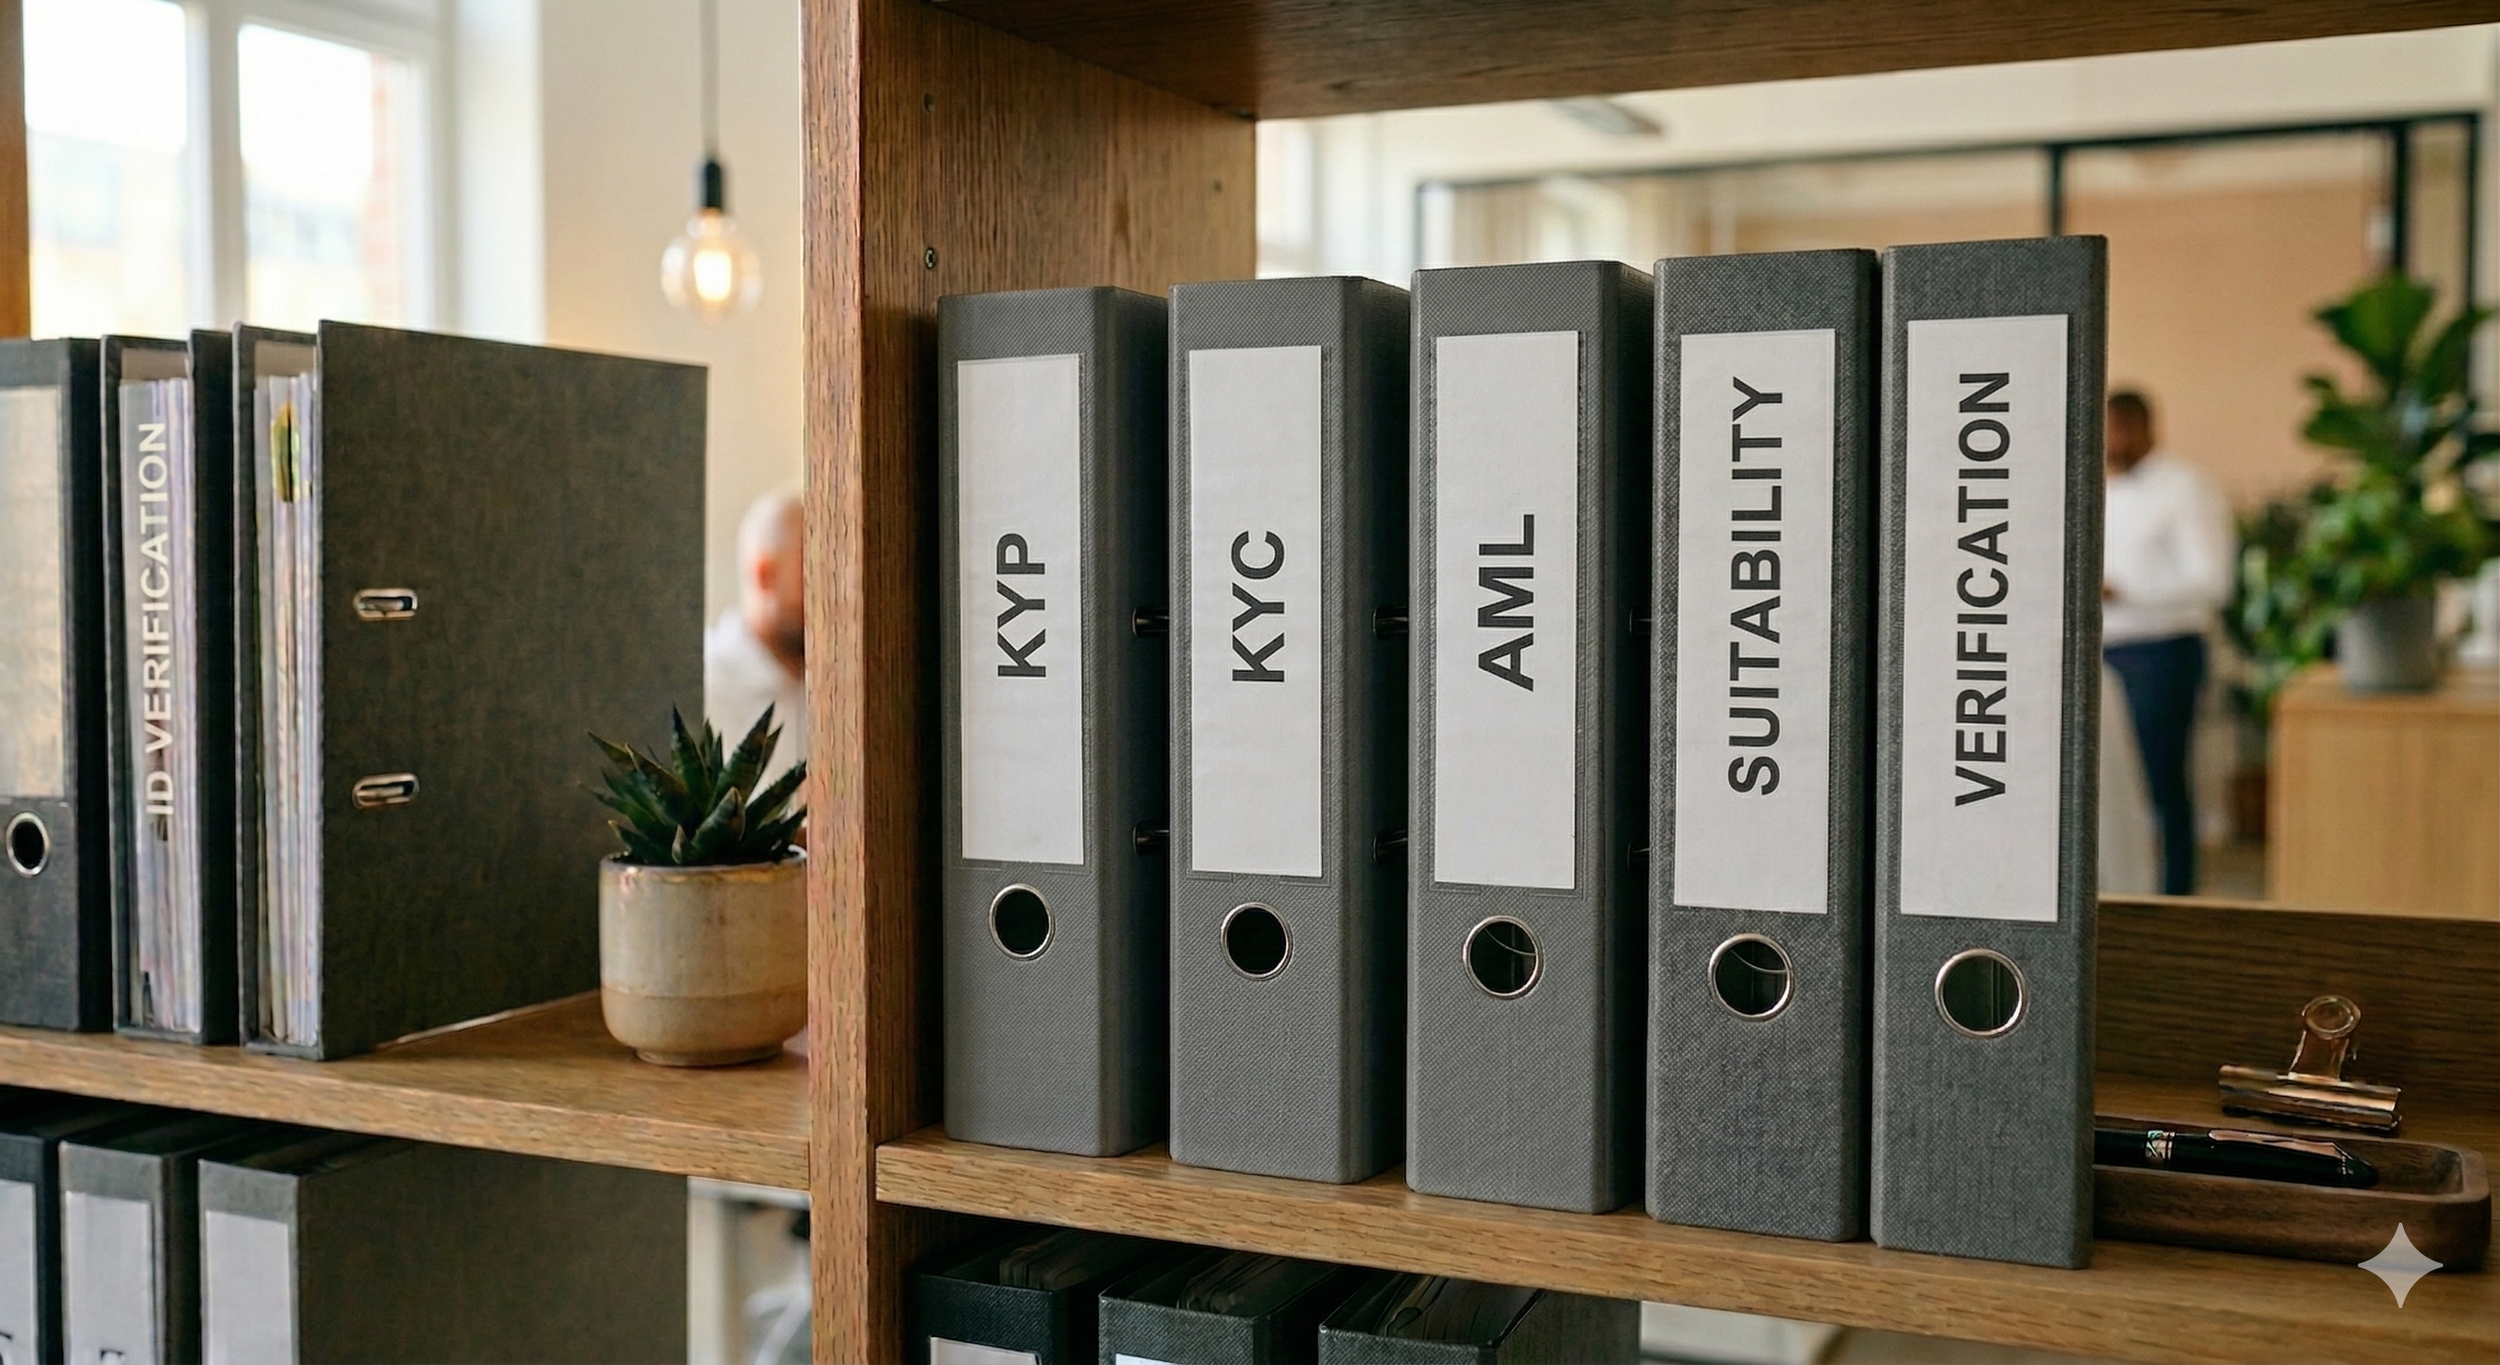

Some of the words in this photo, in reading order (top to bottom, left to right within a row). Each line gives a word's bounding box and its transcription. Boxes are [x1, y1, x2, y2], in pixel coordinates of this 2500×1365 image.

[138, 422, 173, 753] VERIFICATION
[997, 533, 1046, 677] KYP
[1231, 530, 1284, 682] KYC
[1478, 514, 1534, 691] AML
[1728, 377, 1783, 795] SUITABILITY
[1955, 373, 2010, 806] VERIFICATION
[145, 771, 174, 815] ID
